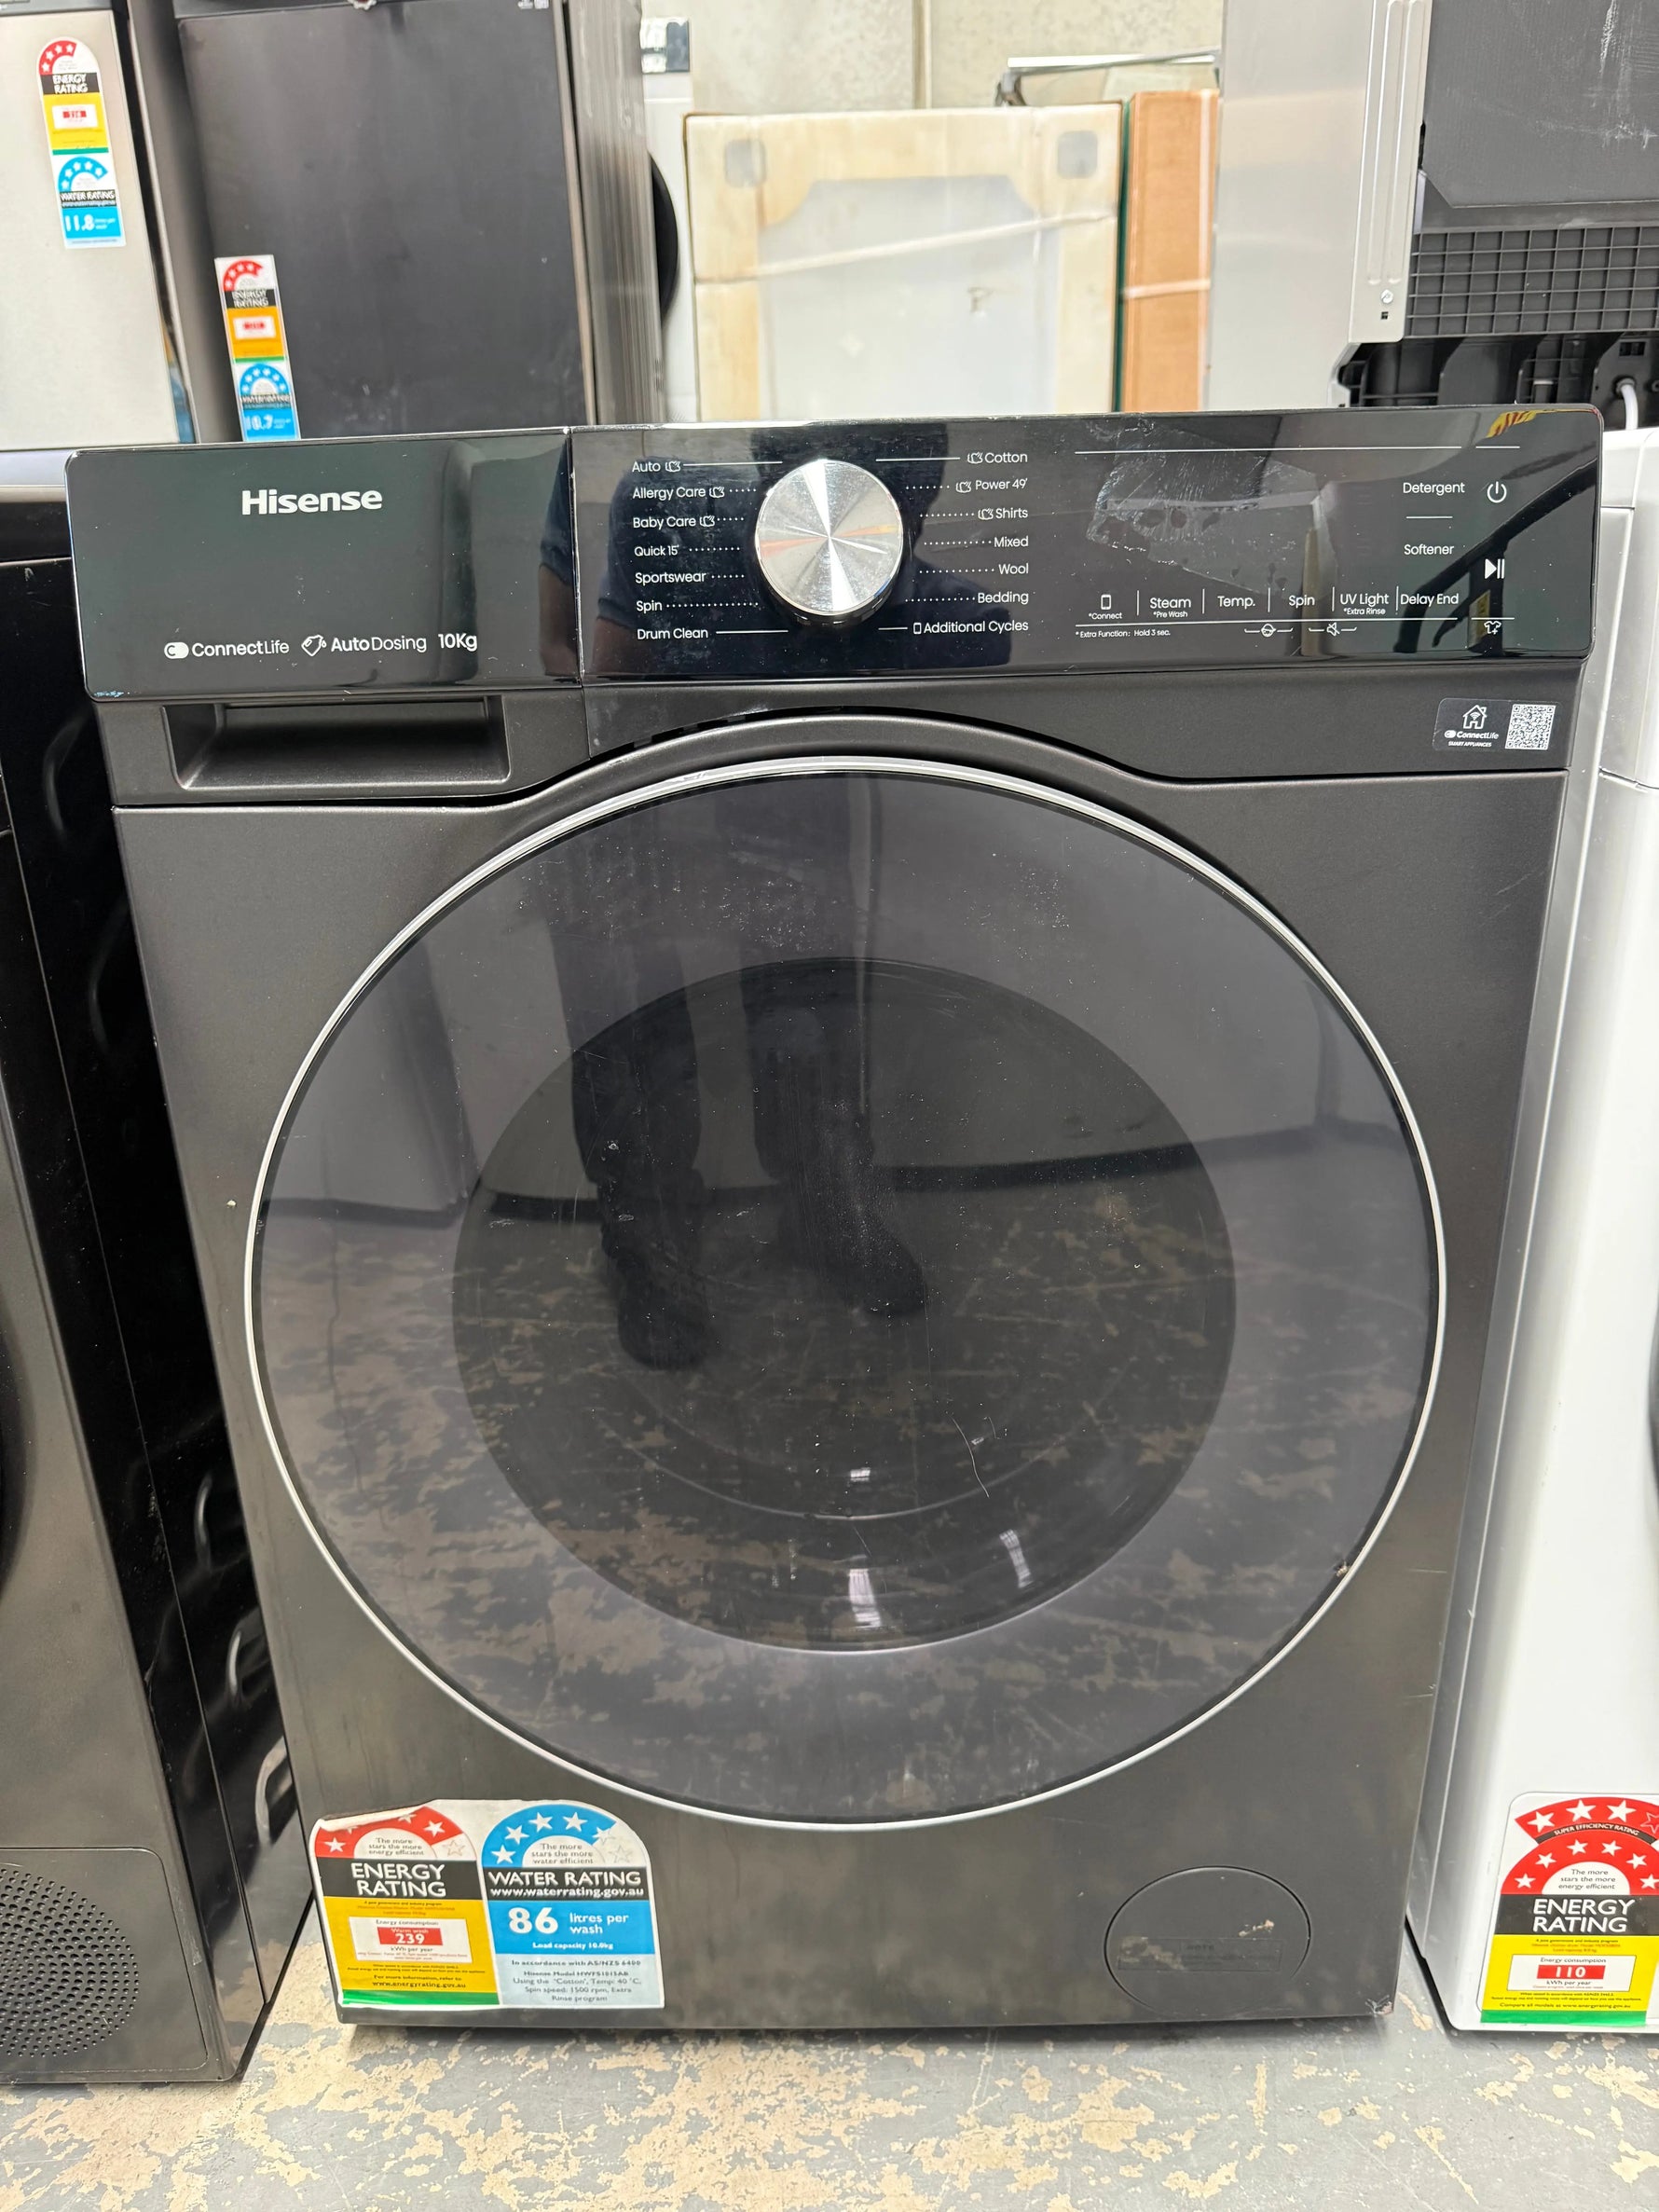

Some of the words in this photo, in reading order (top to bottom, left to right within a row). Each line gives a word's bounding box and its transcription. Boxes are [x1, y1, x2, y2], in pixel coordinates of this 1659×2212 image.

[52, 73, 87, 84] ENERGY
[54, 83, 88, 94] RATING
[61, 192, 87, 201] WATER
[87, 190, 115, 200] RATING
[64, 213, 95, 232] 11.8
[984, 451, 1028, 464] Cotton
[632, 460, 661, 473] Auto
[975, 478, 1010, 490] Power
[1403, 482, 1465, 496] Detergent
[633, 487, 674, 501] Allergy
[676, 487, 706, 498] Care
[241, 488, 383, 515] Hisense
[995, 507, 1028, 519] Shirts
[633, 516, 665, 530] Baby
[666, 515, 697, 528] Care
[994, 535, 1029, 548] Mixed
[634, 545, 665, 556] Quick
[1404, 543, 1455, 555] Softener
[998, 562, 1029, 575] Wool
[635, 571, 707, 586] Sportswear
[978, 591, 1029, 605] Bedding
[1149, 597, 1192, 610] Steam
[1217, 595, 1256, 610] Temp.
[1288, 595, 1315, 608] Spin
[1339, 594, 1358, 605] UV
[1359, 593, 1390, 607] Light
[1400, 593, 1435, 608] Delay
[1436, 593, 1460, 605] End
[636, 599, 663, 613] Spin
[1366, 607, 1386, 615] Rinse
[1168, 610, 1188, 618] Wash
[638, 628, 670, 640] Drum
[673, 627, 708, 639] Clean
[924, 620, 986, 634] Additional
[988, 620, 1029, 634] Cycles
[1079, 629, 1097, 638] Extra
[1098, 628, 1131, 638] Function:
[1133, 628, 1151, 637] Hold
[192, 639, 289, 658] ConnectLife
[331, 634, 427, 653] AutoDosing
[438, 633, 478, 652] 10Kg
[1457, 730, 1500, 739] ConnectLife
[1554, 1826, 1575, 1836] SUPER
[1575, 1822, 1613, 1831] EFFICIENCY
[1613, 1824, 1640, 1836] RATING
[350, 1862, 446, 1881] ENERGY
[487, 1871, 559, 1887] WATER
[564, 1871, 642, 1887] RATING
[356, 1879, 446, 1898] RATING
[490, 1887, 645, 1900] www.waterrating.gov.au
[1533, 1898, 1636, 1916] ENERGY
[508, 1907, 559, 1934] 86
[569, 1912, 603, 1924] litres
[607, 1914, 629, 1926] per
[1532, 1917, 1628, 1932] RATING
[569, 1924, 603, 1935] wash
[395, 1932, 425, 1944] 239
[554, 1942, 586, 1950] capacity
[588, 1942, 614, 1950] 10.0kg
[1556, 1966, 1586, 1978] 110
[513, 1977, 536, 1985] Using
